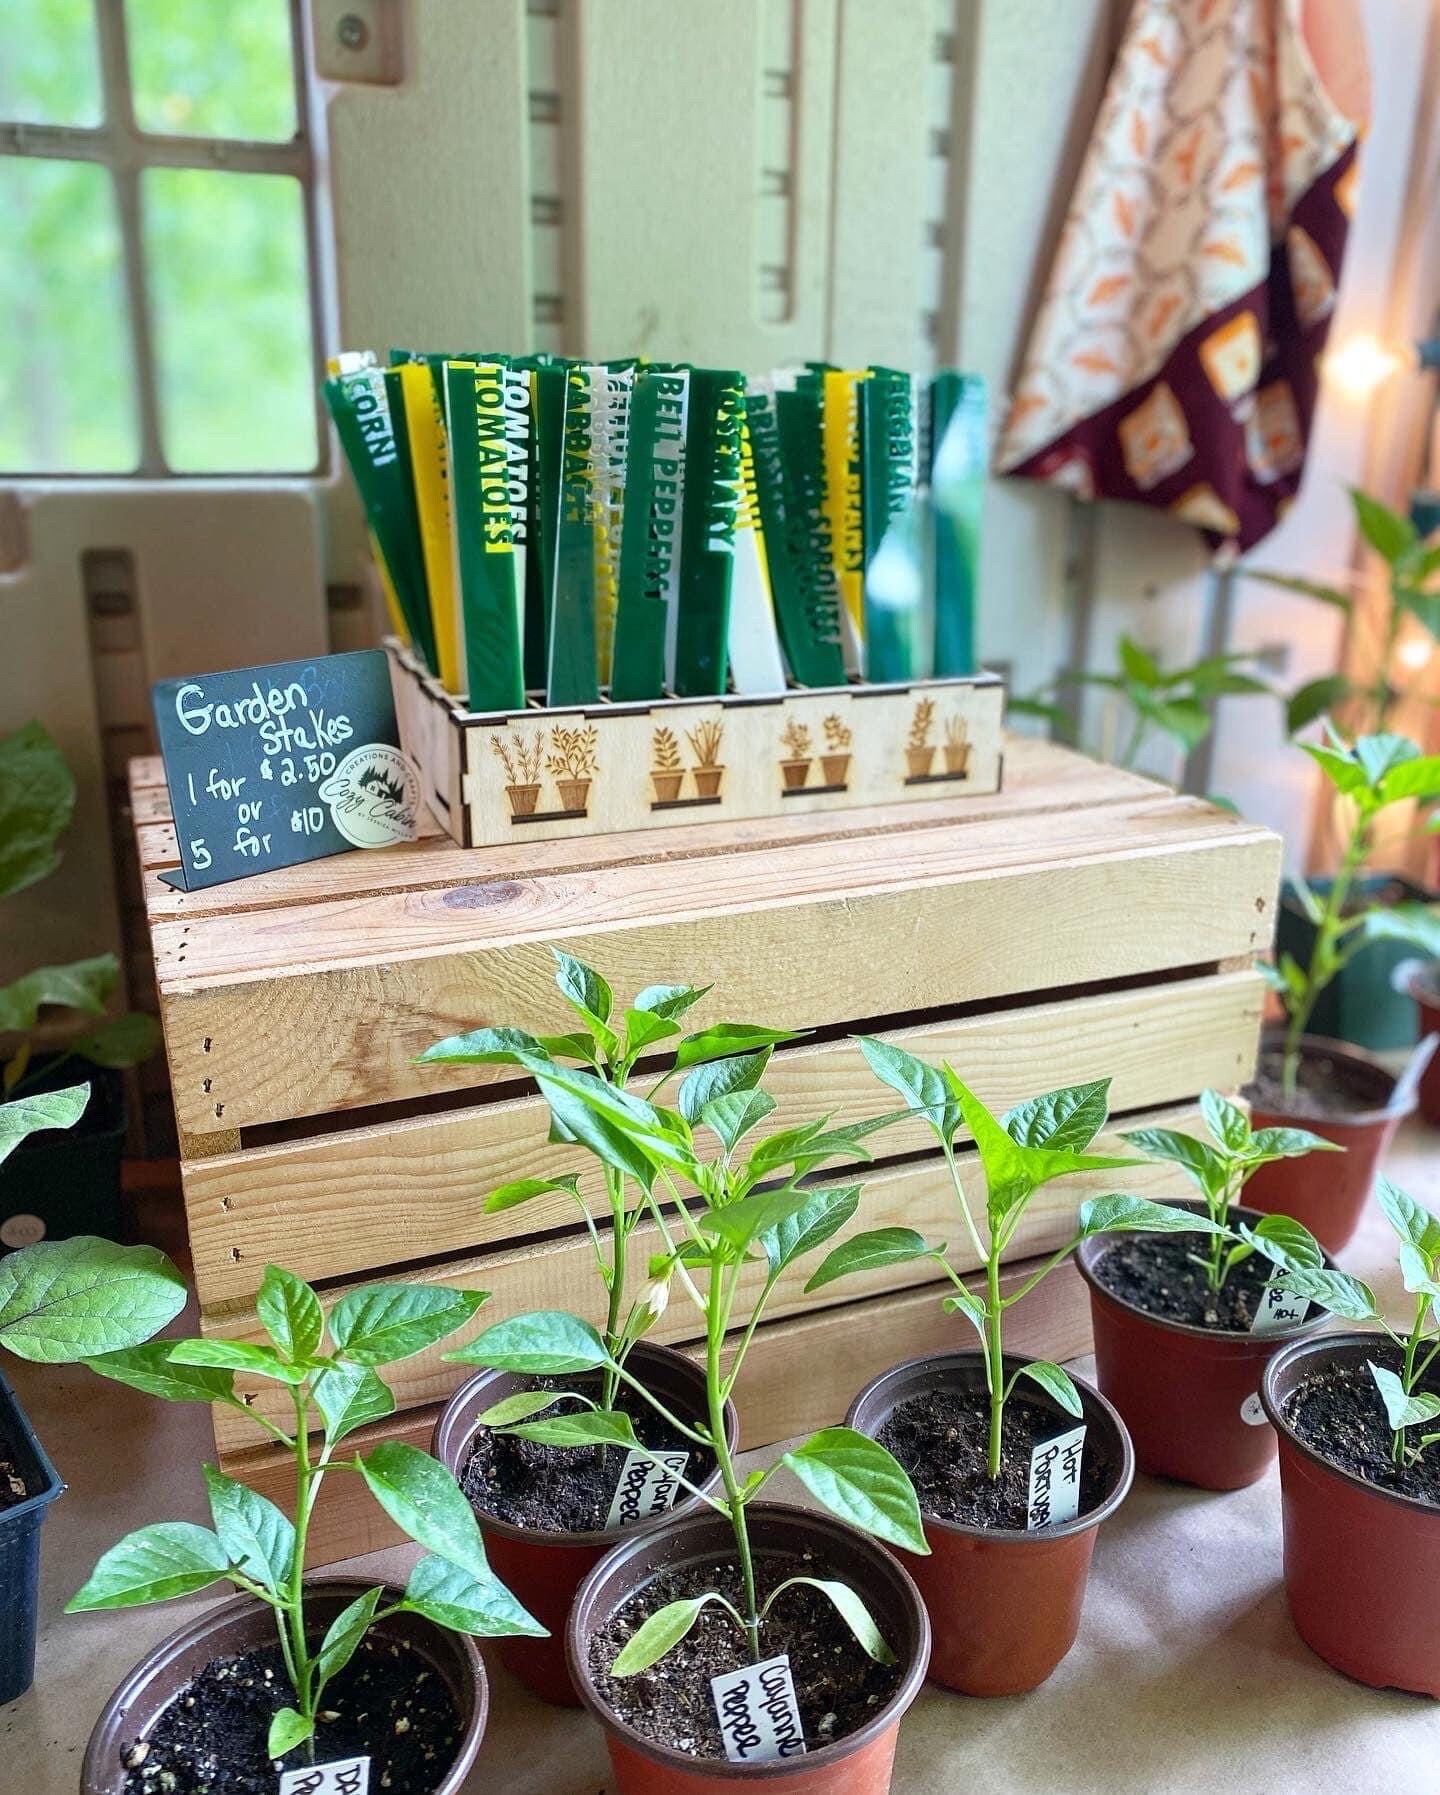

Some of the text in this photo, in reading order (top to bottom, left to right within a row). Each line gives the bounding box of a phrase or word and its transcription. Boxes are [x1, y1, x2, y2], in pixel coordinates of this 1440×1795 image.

[347, 376, 398, 467] CORN
[653, 376, 686, 445] BELL
[475, 367, 513, 548] TOMATOES
[503, 369, 531, 543] TOMATOES
[888, 379, 912, 515] EGGPLAN
[176, 683, 308, 735] Garden
[259, 708, 354, 756] Stakes
[188, 773, 197, 805] 1
[206, 768, 247, 800] for
[346, 753, 389, 775] CREATIONS
[238, 800, 262, 824] or
[324, 779, 417, 829] Cozy Cabin
[190, 807, 324, 870] 5 for $10
